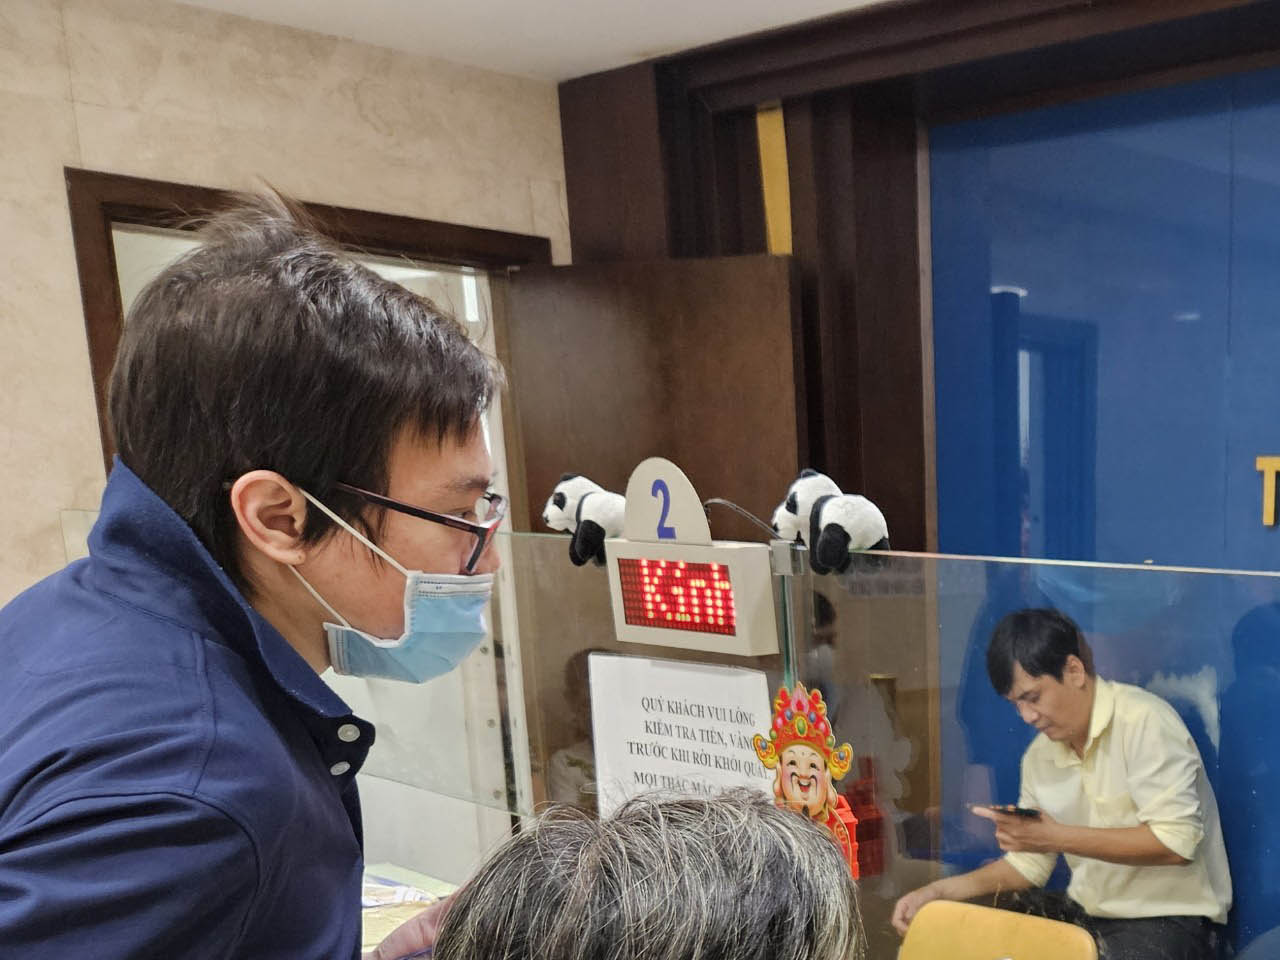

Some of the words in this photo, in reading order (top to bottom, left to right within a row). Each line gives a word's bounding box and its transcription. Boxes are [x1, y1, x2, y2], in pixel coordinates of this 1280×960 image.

[651, 478, 677, 540] 2
[667, 699, 705, 719] KHÁCH
[707, 705, 726, 723] VUI
[674, 725, 697, 741] TRA
[671, 747, 690, 764] KHI
